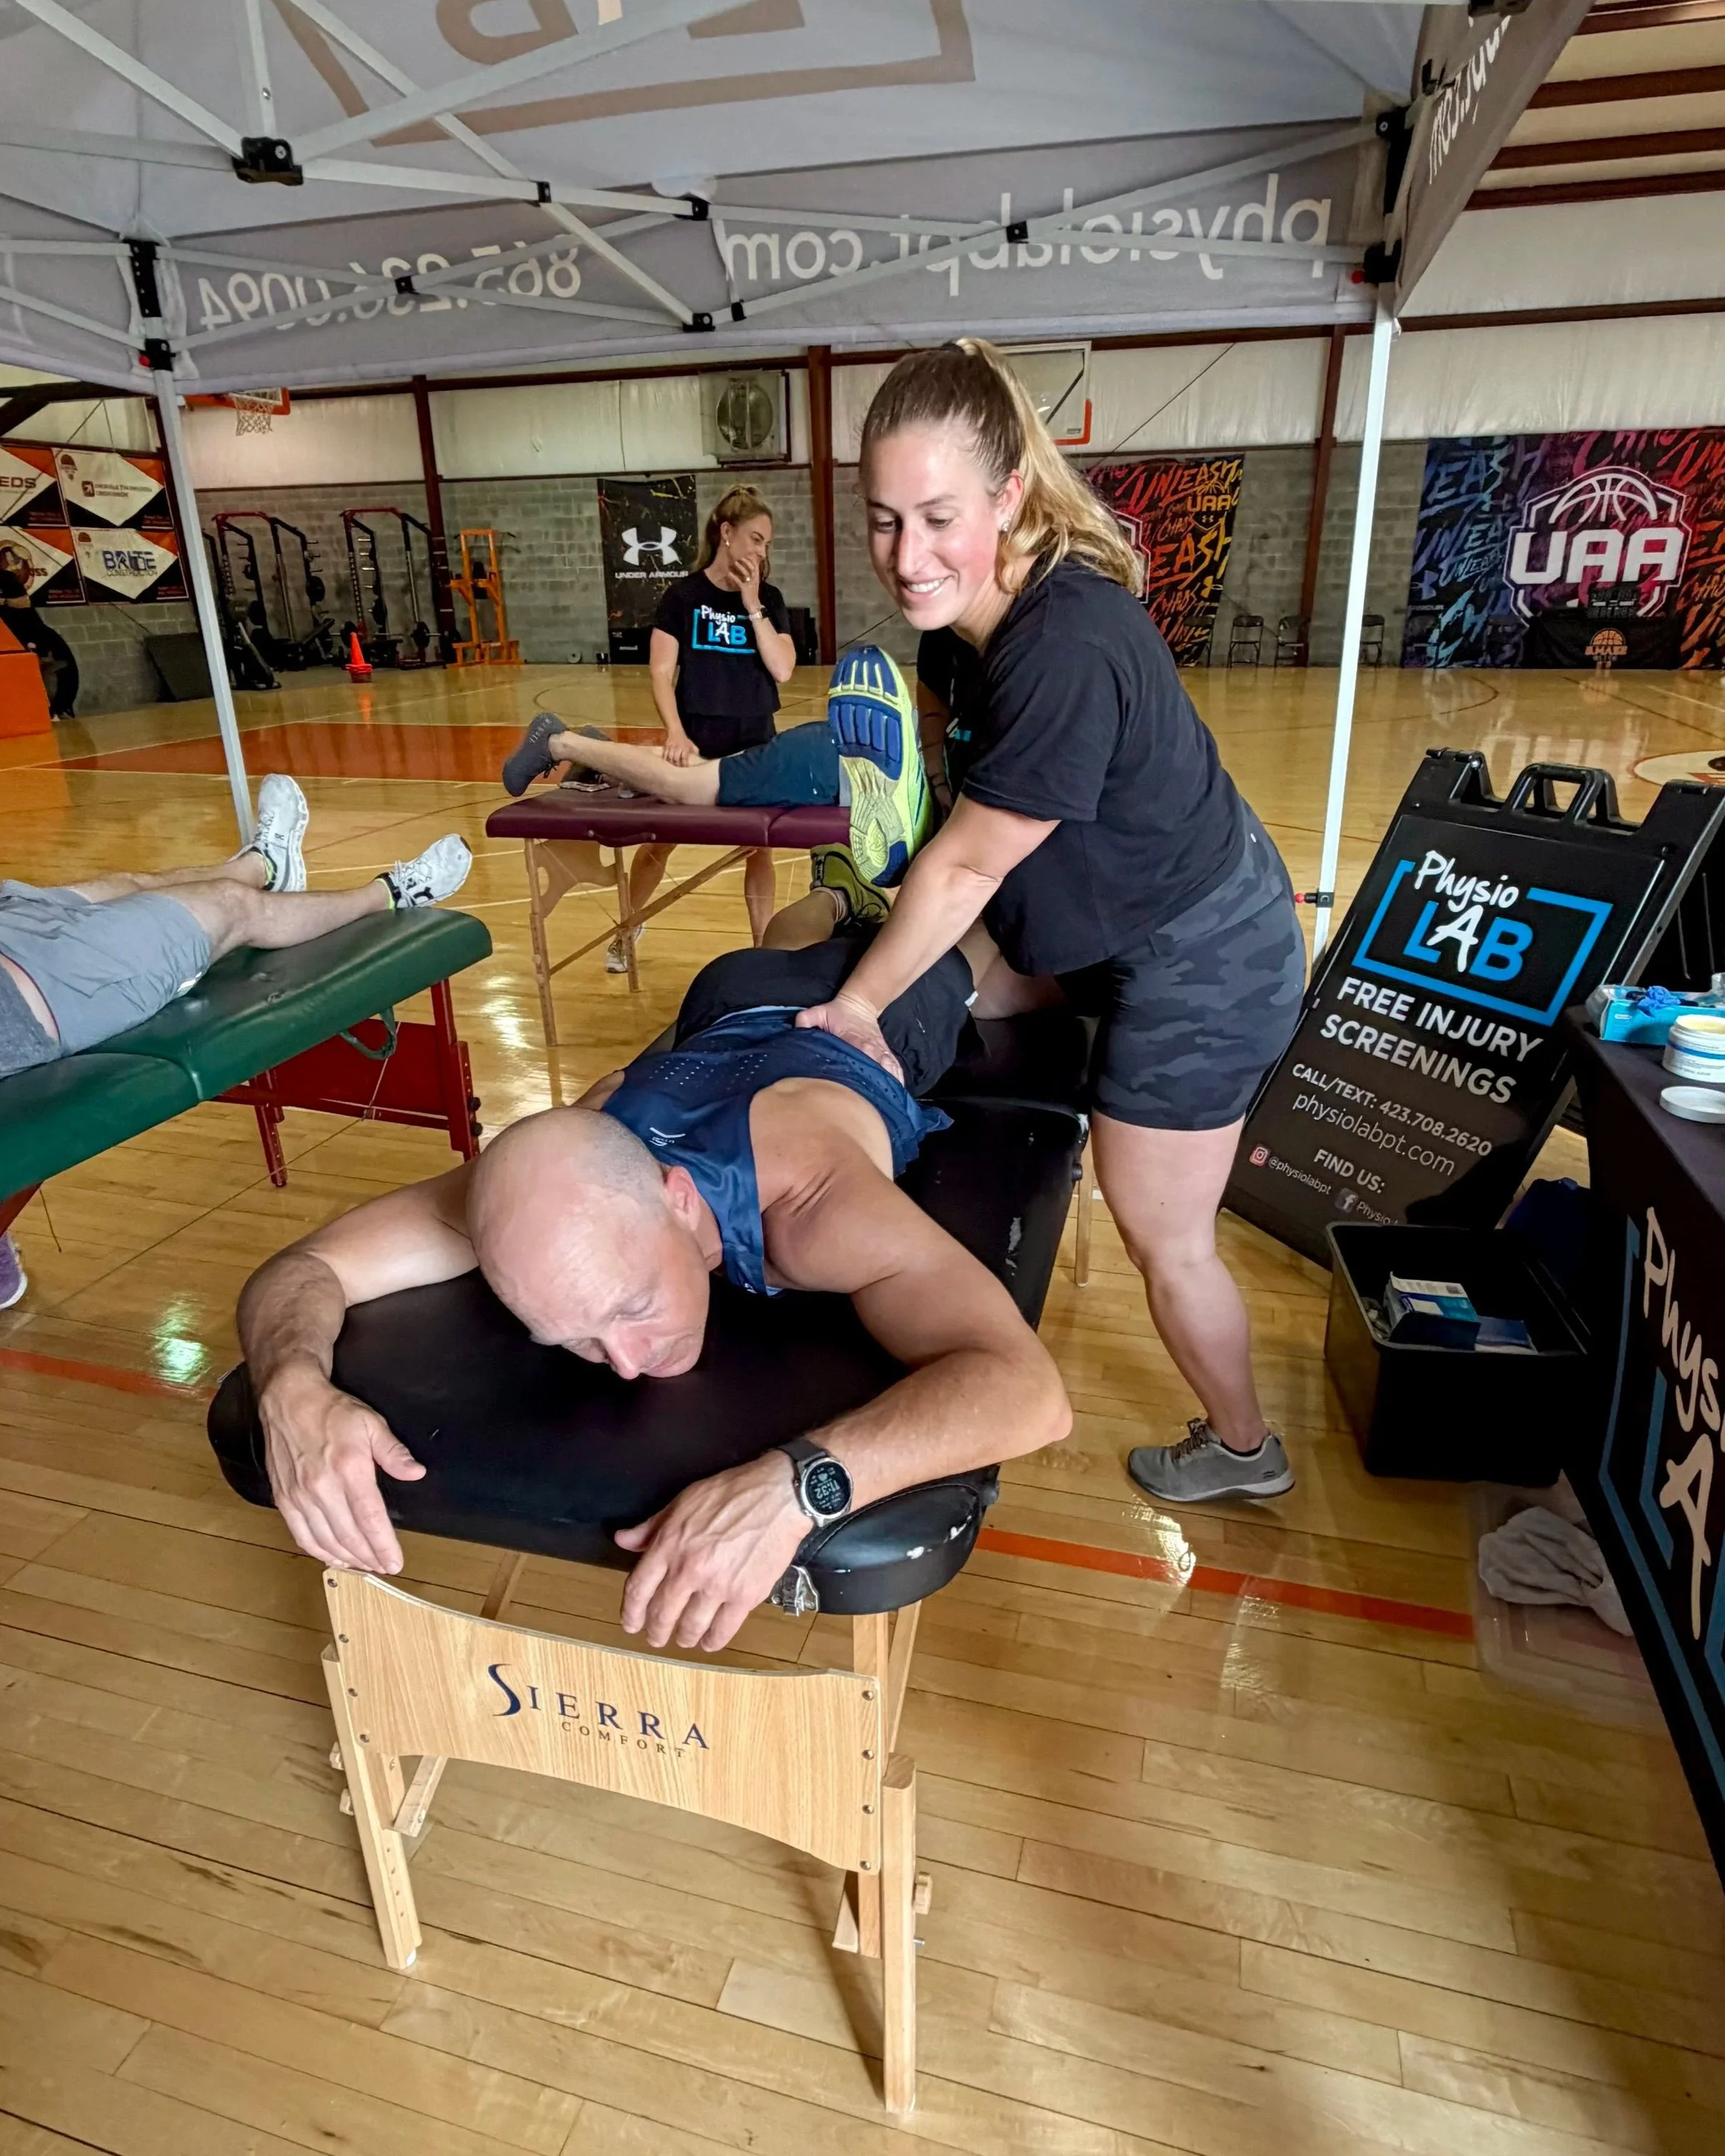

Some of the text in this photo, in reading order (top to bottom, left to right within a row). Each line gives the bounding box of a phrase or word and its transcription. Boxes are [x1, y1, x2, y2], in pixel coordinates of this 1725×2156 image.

[1187, 495, 1230, 512] UAA
[1509, 527, 1684, 584] UAA
[700, 604, 736, 624] Physio
[708, 622, 747, 644] LAB
[1414, 850, 1519, 912] Physio
[1403, 900, 1534, 982] LAB
[1337, 976, 1544, 1063] FREE INJURY
[1320, 1013, 1517, 1104] SCREENINGS
[1293, 1063, 1493, 1157] CALL/TEXT: 423.708.2620
[1293, 1093, 1455, 1177] physiolabpt.com
[1268, 1156, 1332, 1196] @physiolabpt
[1314, 1148, 1386, 1194] FIND US:
[561, 1721, 685, 1758] COMFORT
